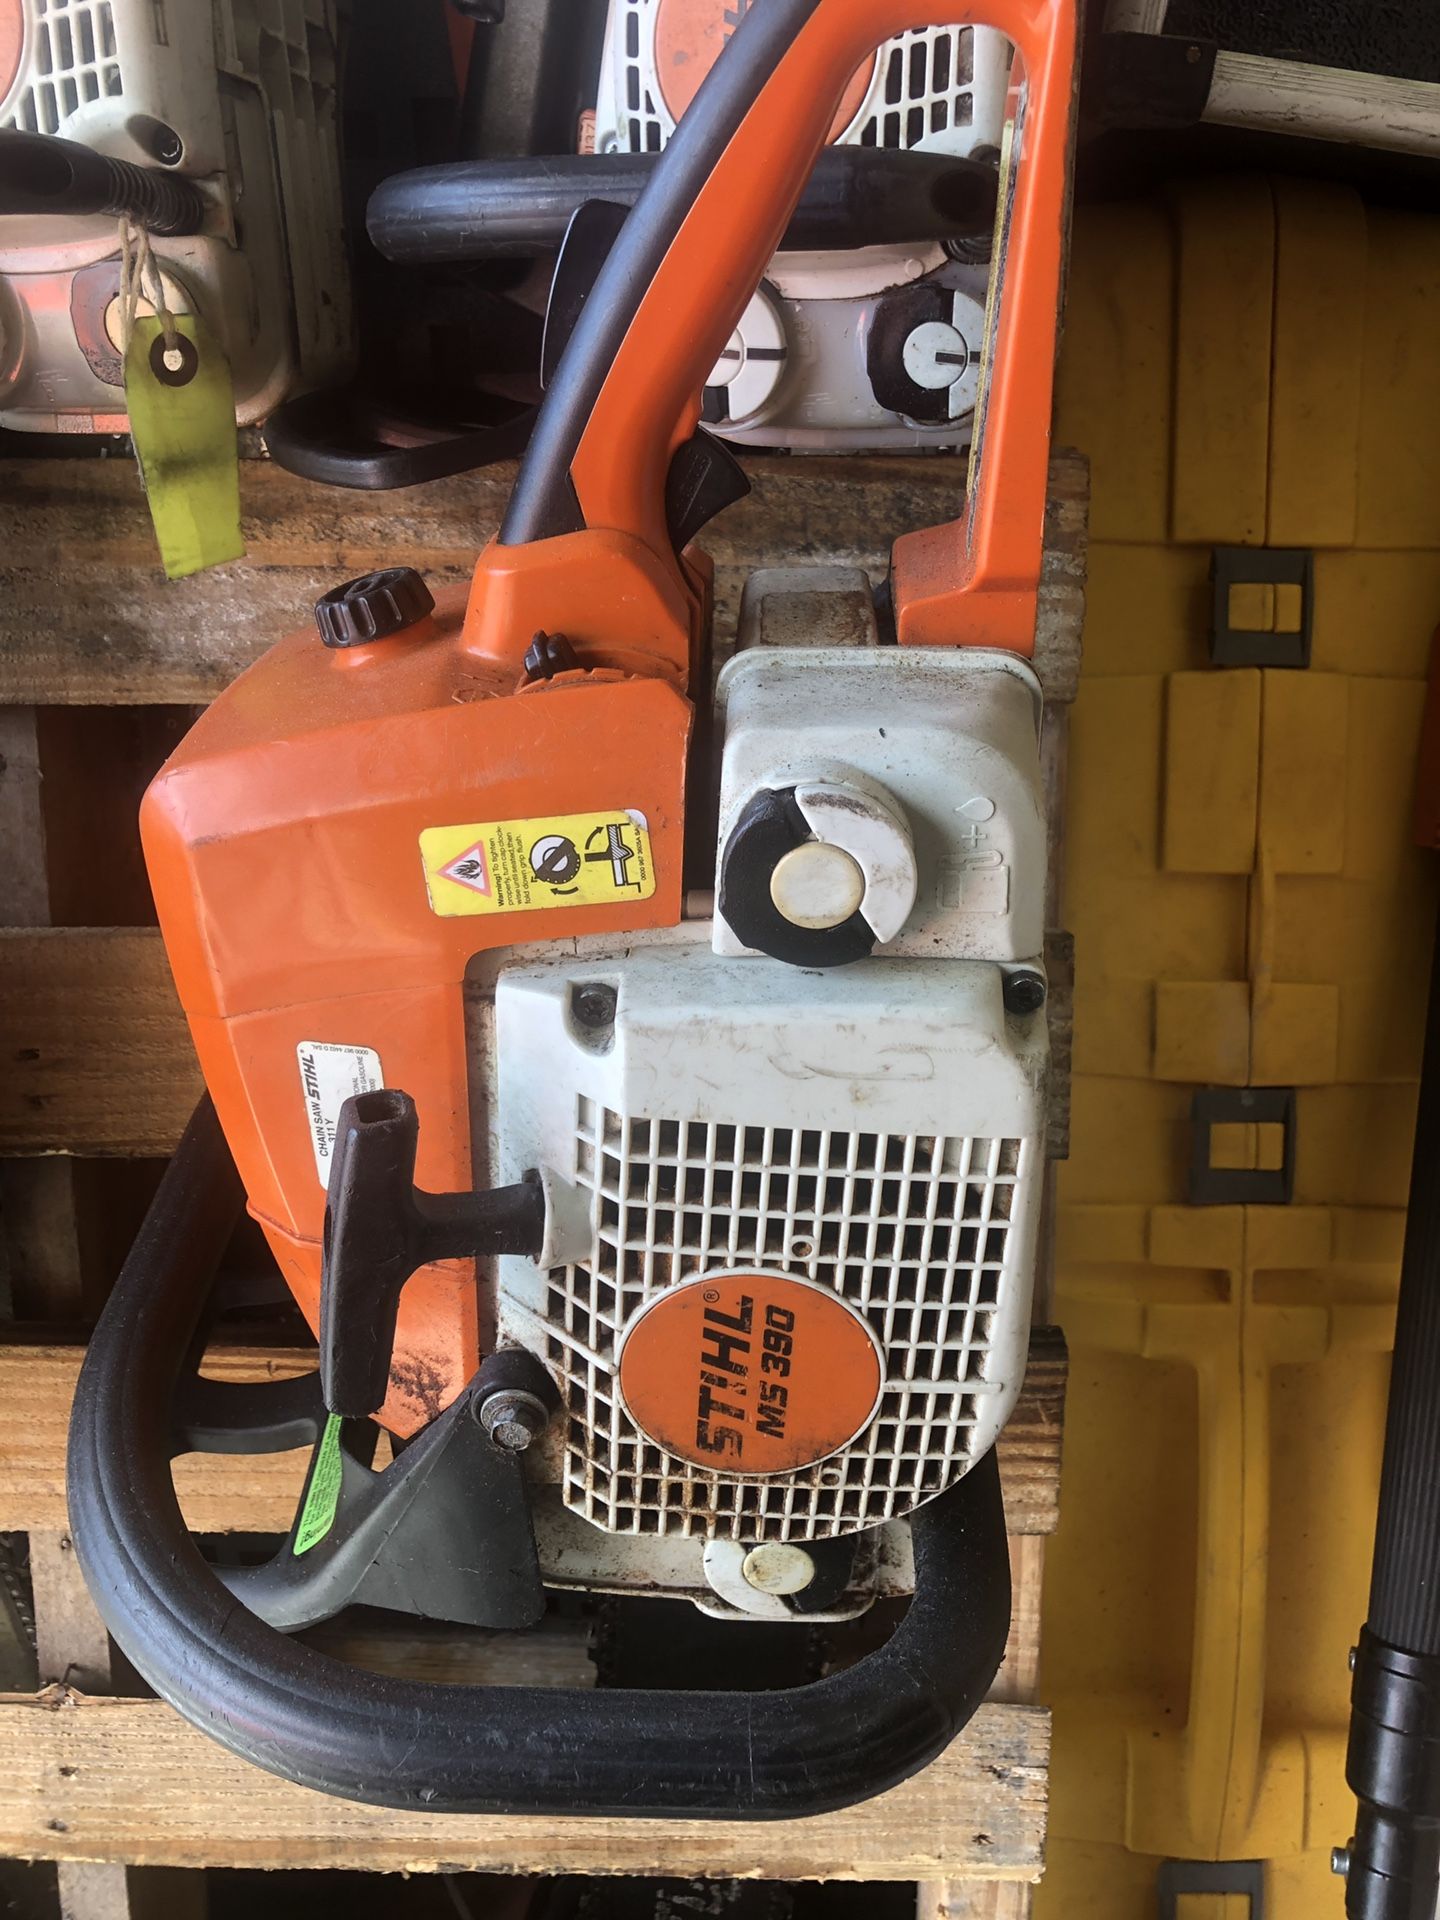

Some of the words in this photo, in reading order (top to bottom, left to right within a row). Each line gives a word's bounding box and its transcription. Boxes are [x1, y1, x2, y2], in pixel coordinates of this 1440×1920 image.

[496, 826, 505, 847] clock-
[489, 838, 499, 863] tighten
[519, 854, 527, 869] grip
[492, 863, 499, 872] To
[521, 870, 529, 889] down
[639, 867, 647, 881] 0000
[494, 874, 505, 907] Warning!
[503, 876, 514, 906] properly,
[512, 873, 520, 888] until
[523, 890, 532, 904] fold
[302, 1053, 320, 1101] STIHL
[356, 1055, 367, 1085] GASOLINE
[310, 1101, 323, 1123] SAW
[315, 1126, 328, 1157] CHAIN
[761, 1304, 795, 1378] 390
[697, 1295, 753, 1457] STIHL
[755, 1380, 788, 1439] MS
